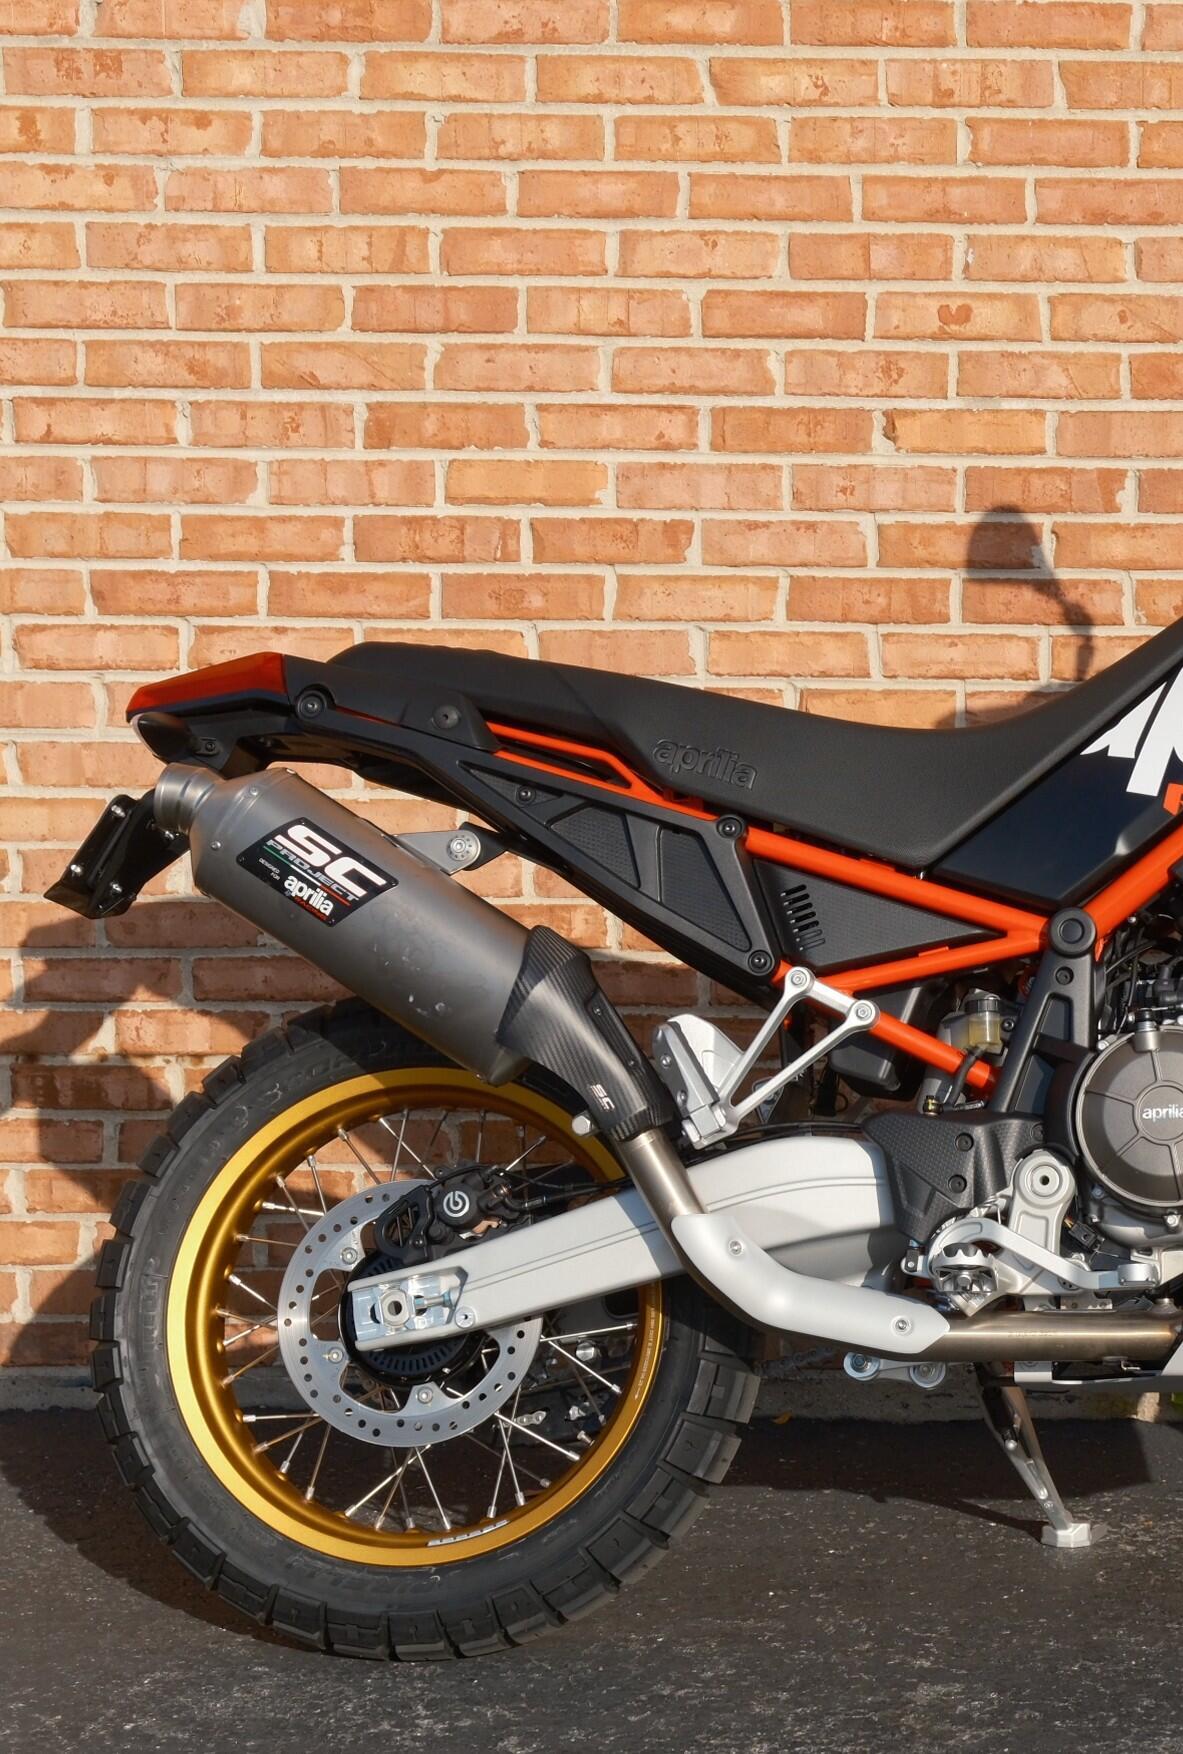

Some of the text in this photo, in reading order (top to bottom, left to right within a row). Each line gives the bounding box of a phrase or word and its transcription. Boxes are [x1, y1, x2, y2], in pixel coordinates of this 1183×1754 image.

[653, 739, 758, 790] aprilia
[266, 839, 359, 900] PROJECT
[273, 824, 387, 897] SC
[284, 875, 333, 916] aprilia
